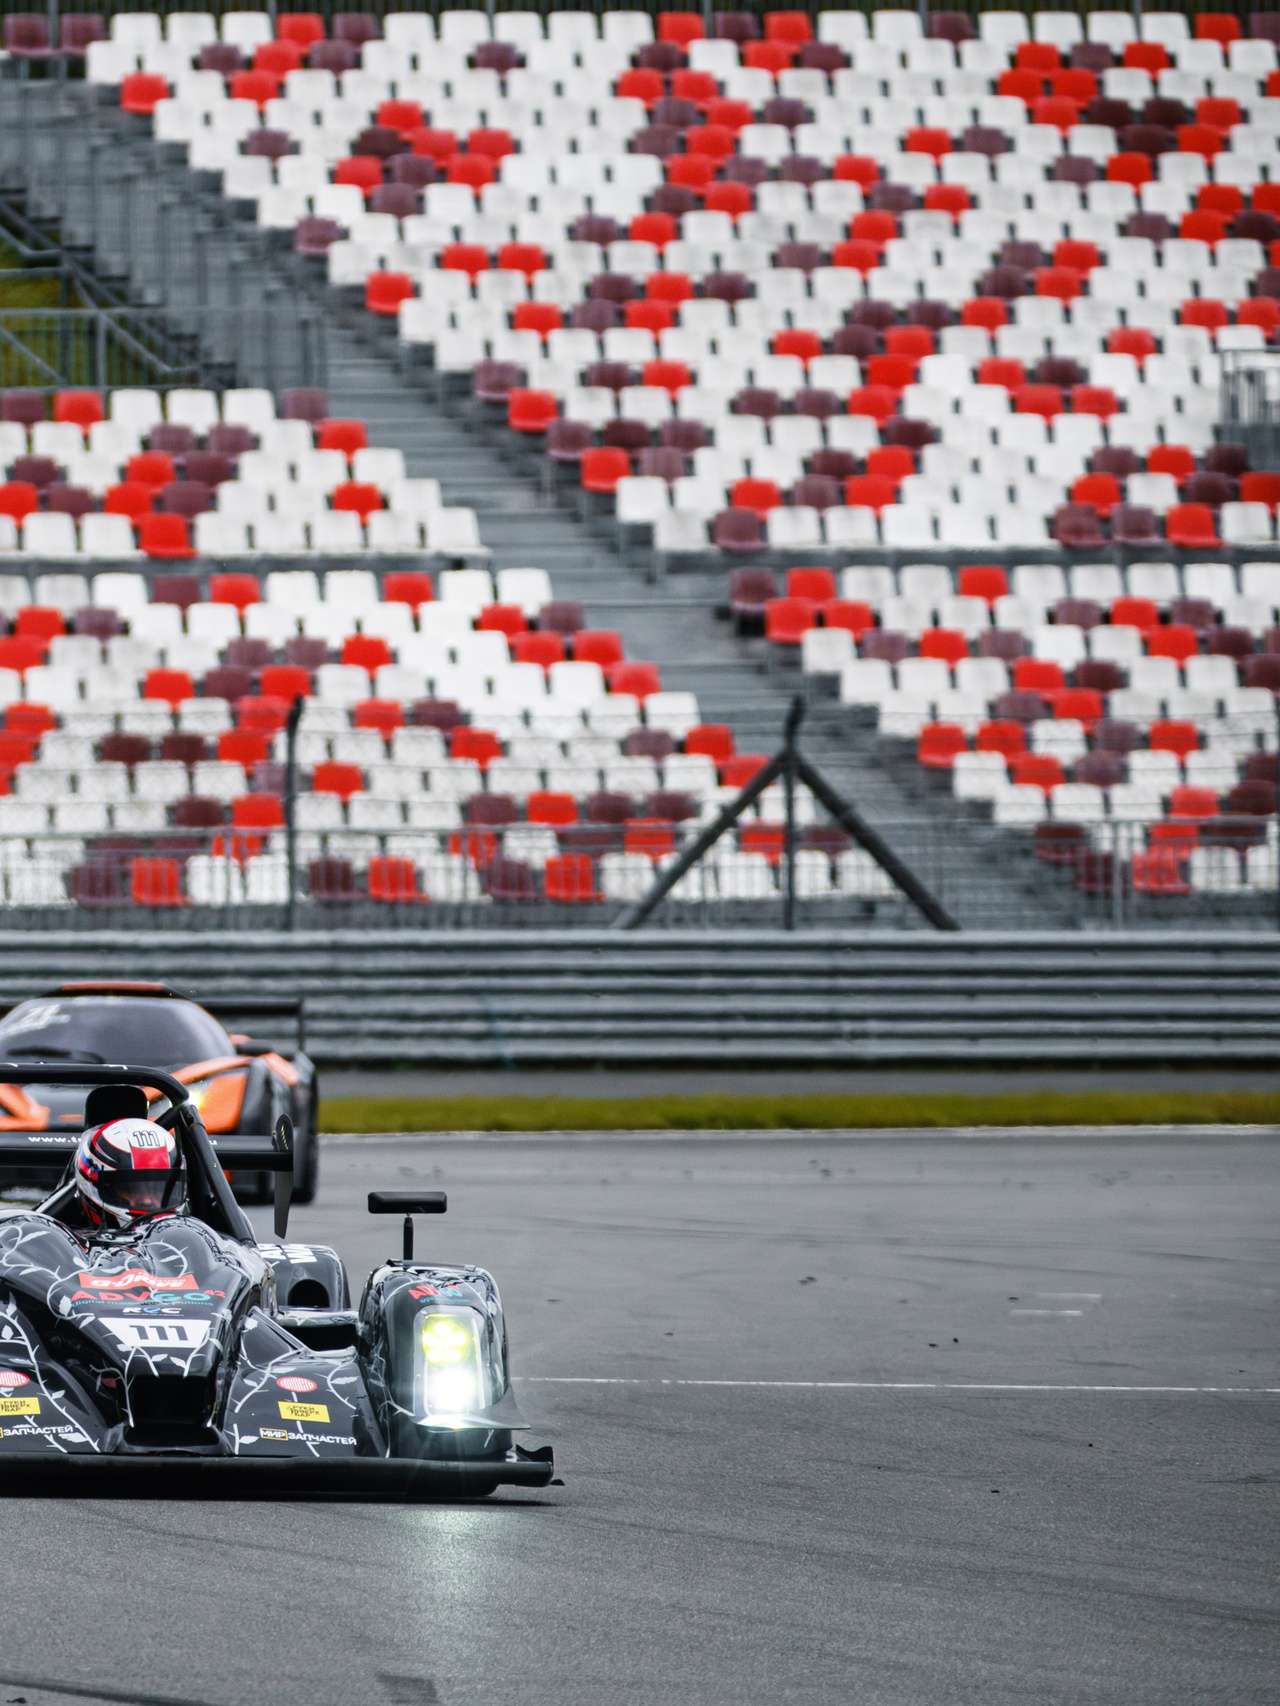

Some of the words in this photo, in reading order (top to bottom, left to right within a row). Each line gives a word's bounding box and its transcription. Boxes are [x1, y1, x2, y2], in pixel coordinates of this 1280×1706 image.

[133, 1130, 161, 1147] 111
[129, 1325, 189, 1341] 111
[3, 1425, 74, 1436] ЗАПЧАСТЕЙ
[260, 1429, 286, 1438] МИР
[287, 1432, 357, 1445] ЗАПЧАСТЕЙ
